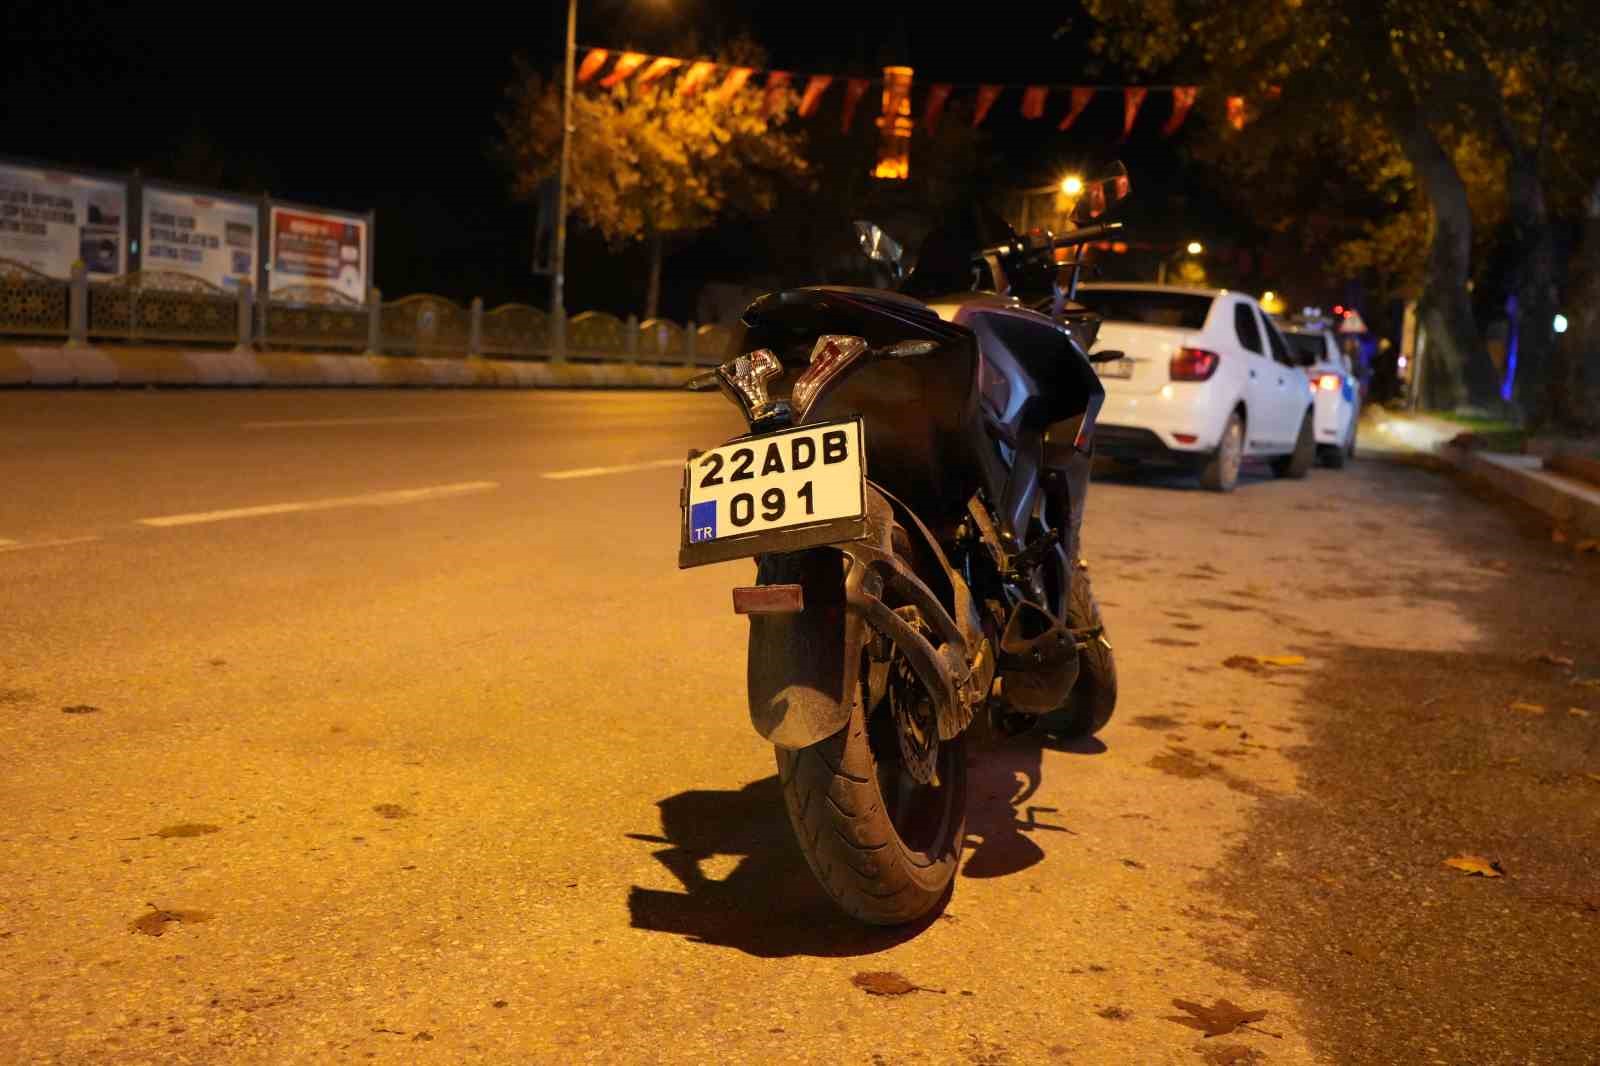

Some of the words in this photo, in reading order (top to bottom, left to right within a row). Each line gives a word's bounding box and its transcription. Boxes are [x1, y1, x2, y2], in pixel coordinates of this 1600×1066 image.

[700, 430, 849, 489] 22ADB
[730, 481, 815, 528] 091
[695, 526, 713, 541] TR
